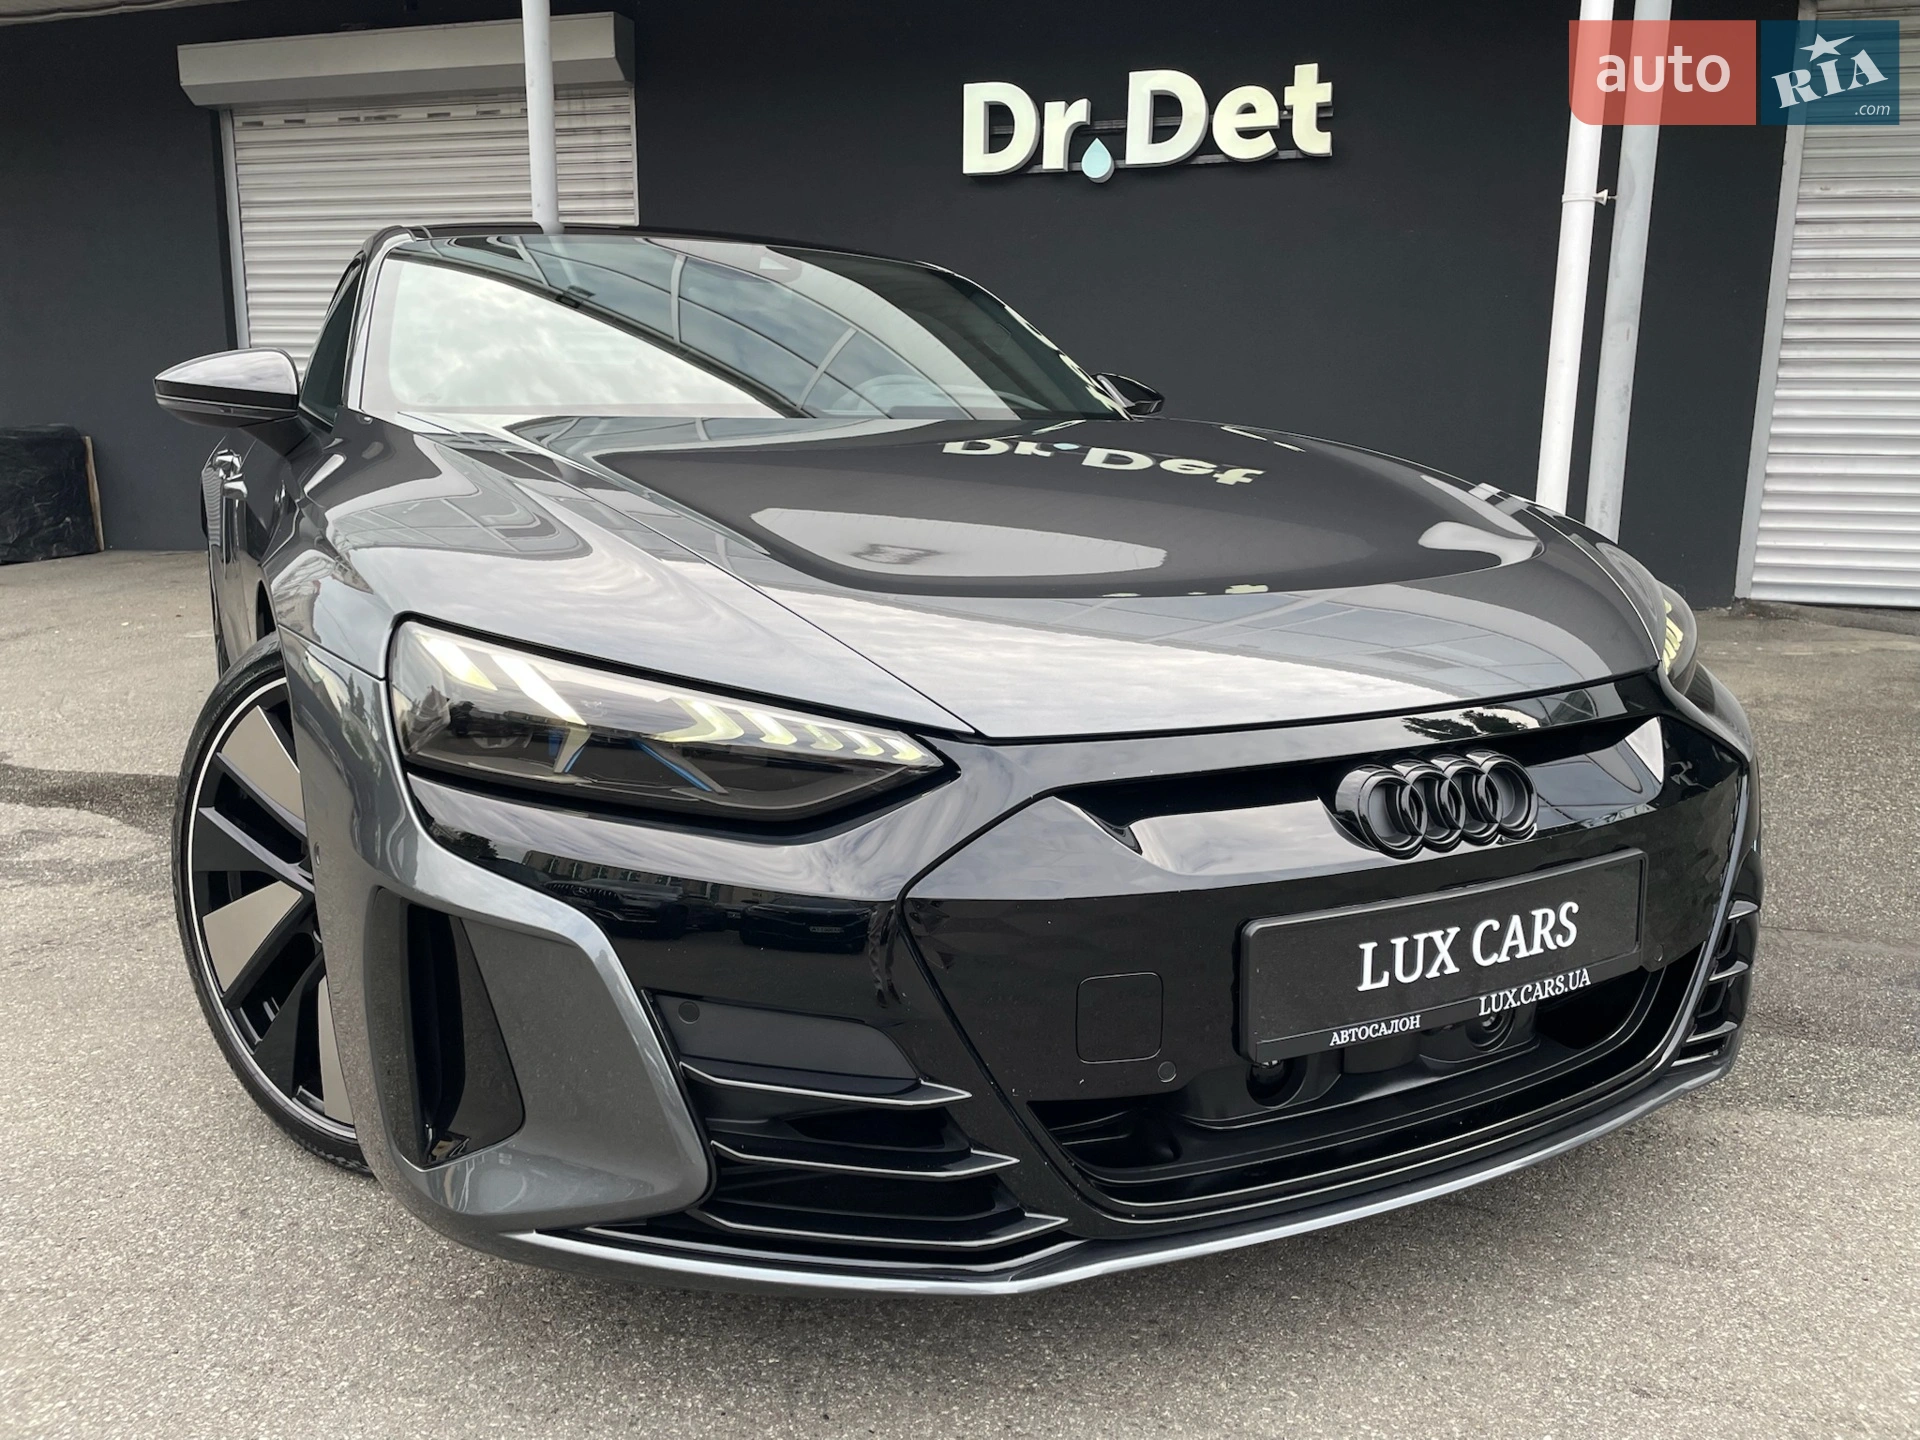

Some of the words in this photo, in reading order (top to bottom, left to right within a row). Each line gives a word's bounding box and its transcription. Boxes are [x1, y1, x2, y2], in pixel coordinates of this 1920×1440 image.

[1357, 926, 1461, 992] LUX
[1471, 901, 1579, 967] CARS
[1478, 967, 1592, 1017] LUX.CARS.UA
[1329, 1014, 1421, 1047] АВТОСАЛОН
